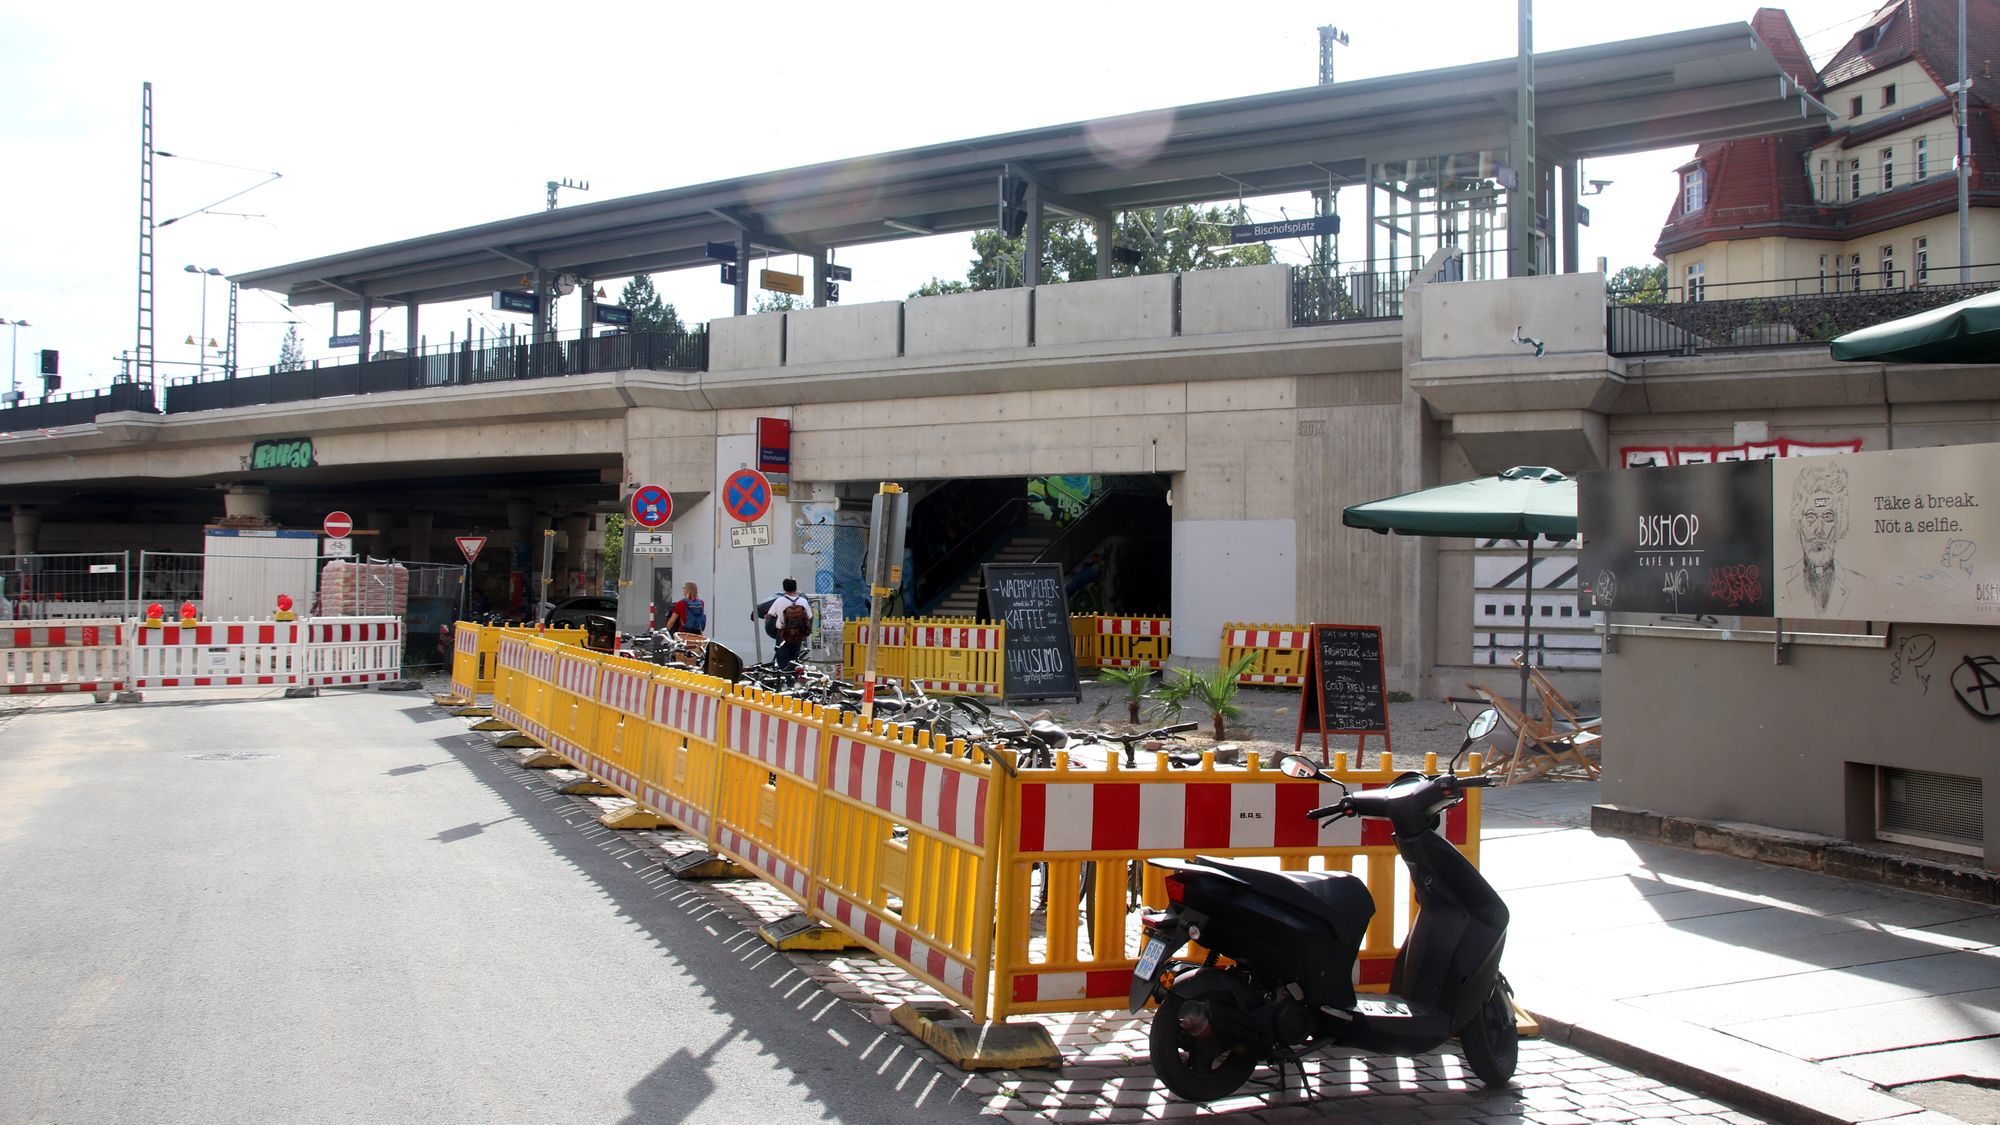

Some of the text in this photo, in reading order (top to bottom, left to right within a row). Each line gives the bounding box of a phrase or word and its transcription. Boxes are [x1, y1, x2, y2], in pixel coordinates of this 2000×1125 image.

[1255, 222, 1315, 236] Bischofsplatz
[724, 265, 729, 280] 1
[831, 284, 838, 297] 2
[1874, 496, 1910, 510] Täke
[1928, 493, 1979, 508] break.
[1639, 514, 1699, 546] BISHOP
[1874, 517, 1963, 533] Nöt a selfie.
[1640, 556, 1700, 566] CAFÉ & BAR
[1000, 579, 1060, 598] WACHMACHER
[1005, 609, 1047, 630] KAFFEE
[1326, 681, 1344, 692] COLD
[1347, 681, 1365, 693] BREW
[1339, 718, 1374, 729] BISHOP
[1146, 942, 1163, 960] 686
